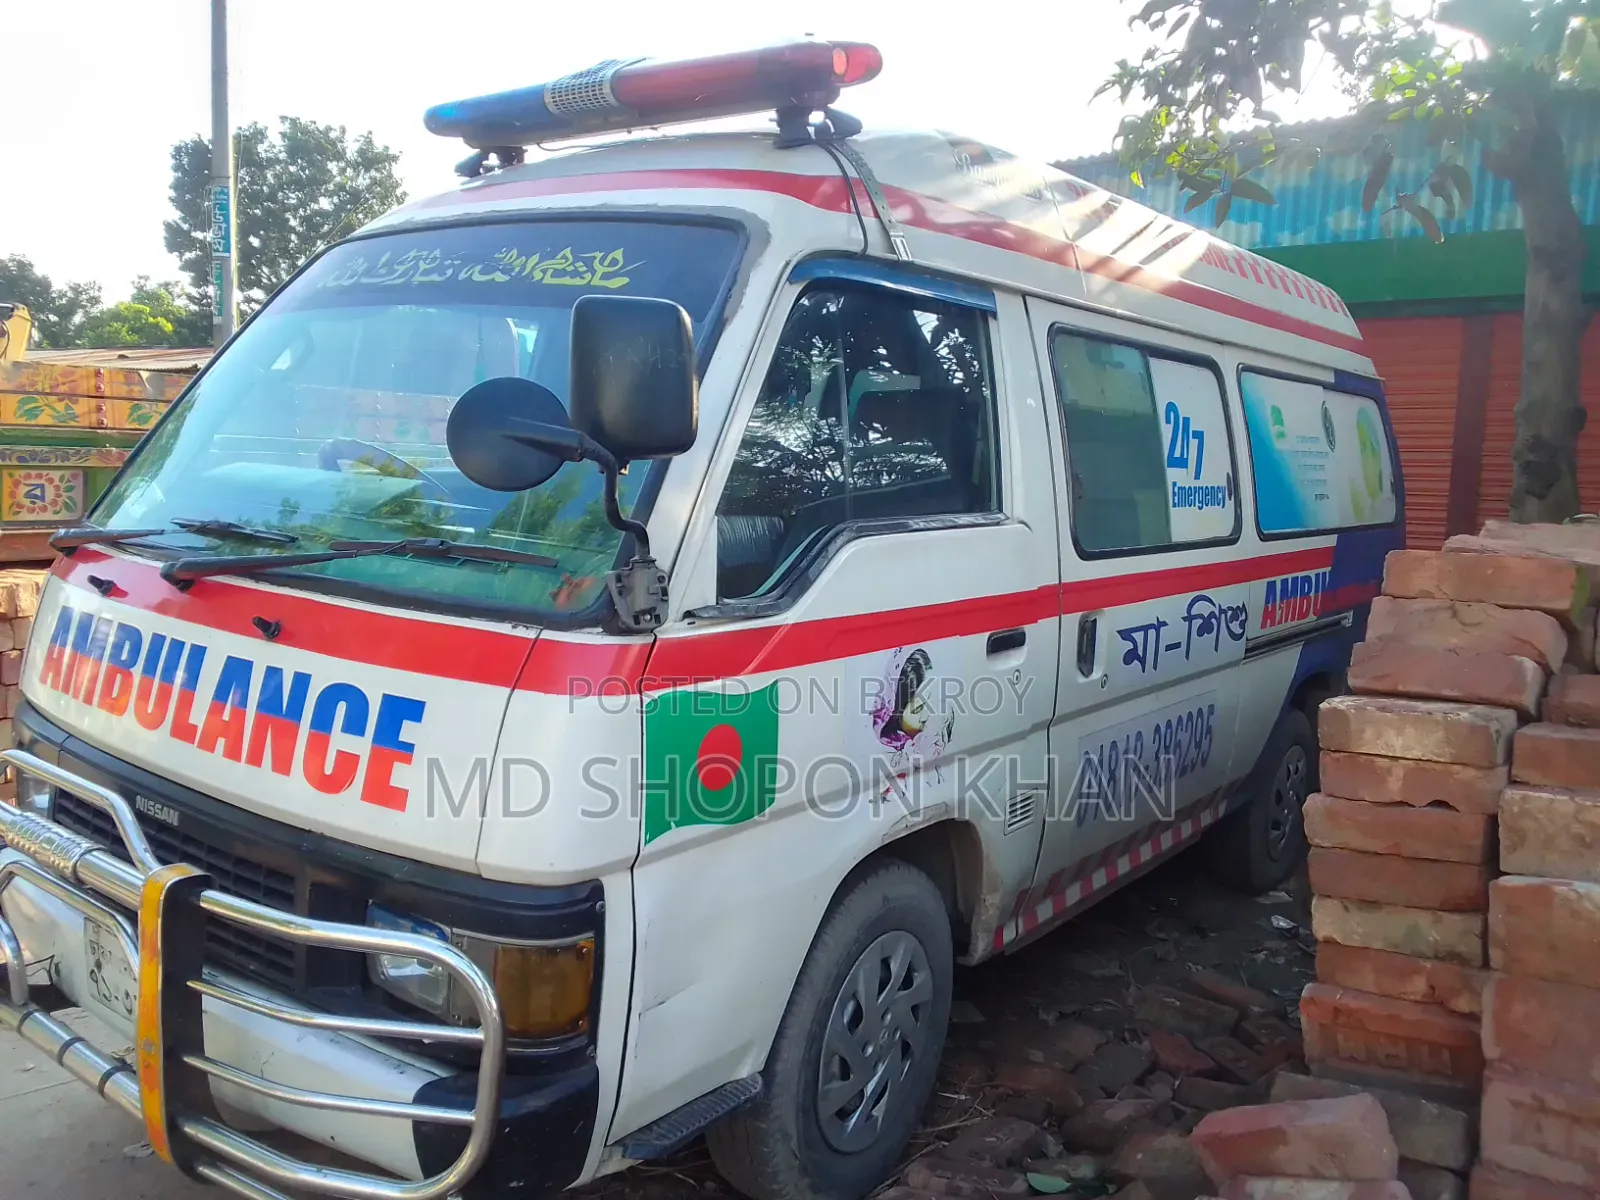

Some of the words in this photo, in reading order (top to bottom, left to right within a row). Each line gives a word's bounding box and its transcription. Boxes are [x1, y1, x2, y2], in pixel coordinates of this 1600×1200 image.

[1172, 481, 1227, 511] Emergency
[39, 605, 427, 812] AMBULANCE
[135, 795, 179, 826] NISSAN
